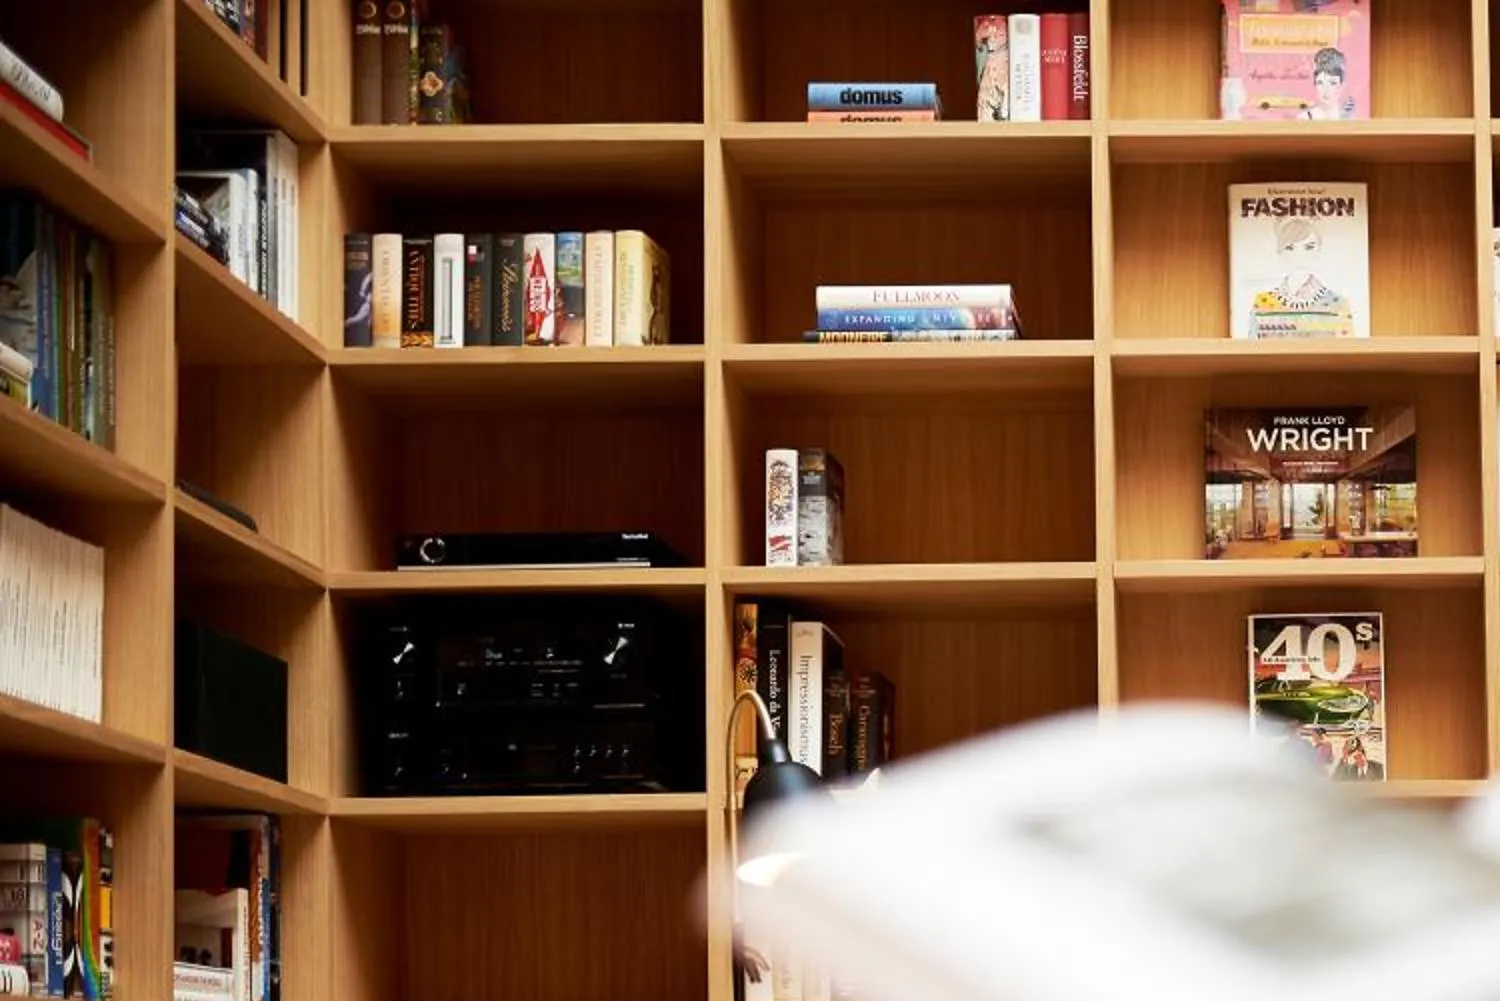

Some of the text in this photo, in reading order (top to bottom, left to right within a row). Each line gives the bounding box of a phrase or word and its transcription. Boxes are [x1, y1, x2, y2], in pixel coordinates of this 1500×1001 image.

[840, 87, 903, 105] domus
[1241, 197, 1355, 217] FASHION
[1273, 415, 1345, 425] FRANK LLOYD
[1246, 427, 1373, 451] WRIGHT
[769, 650, 781, 698] Leonardo
[769, 701, 781, 713] da
